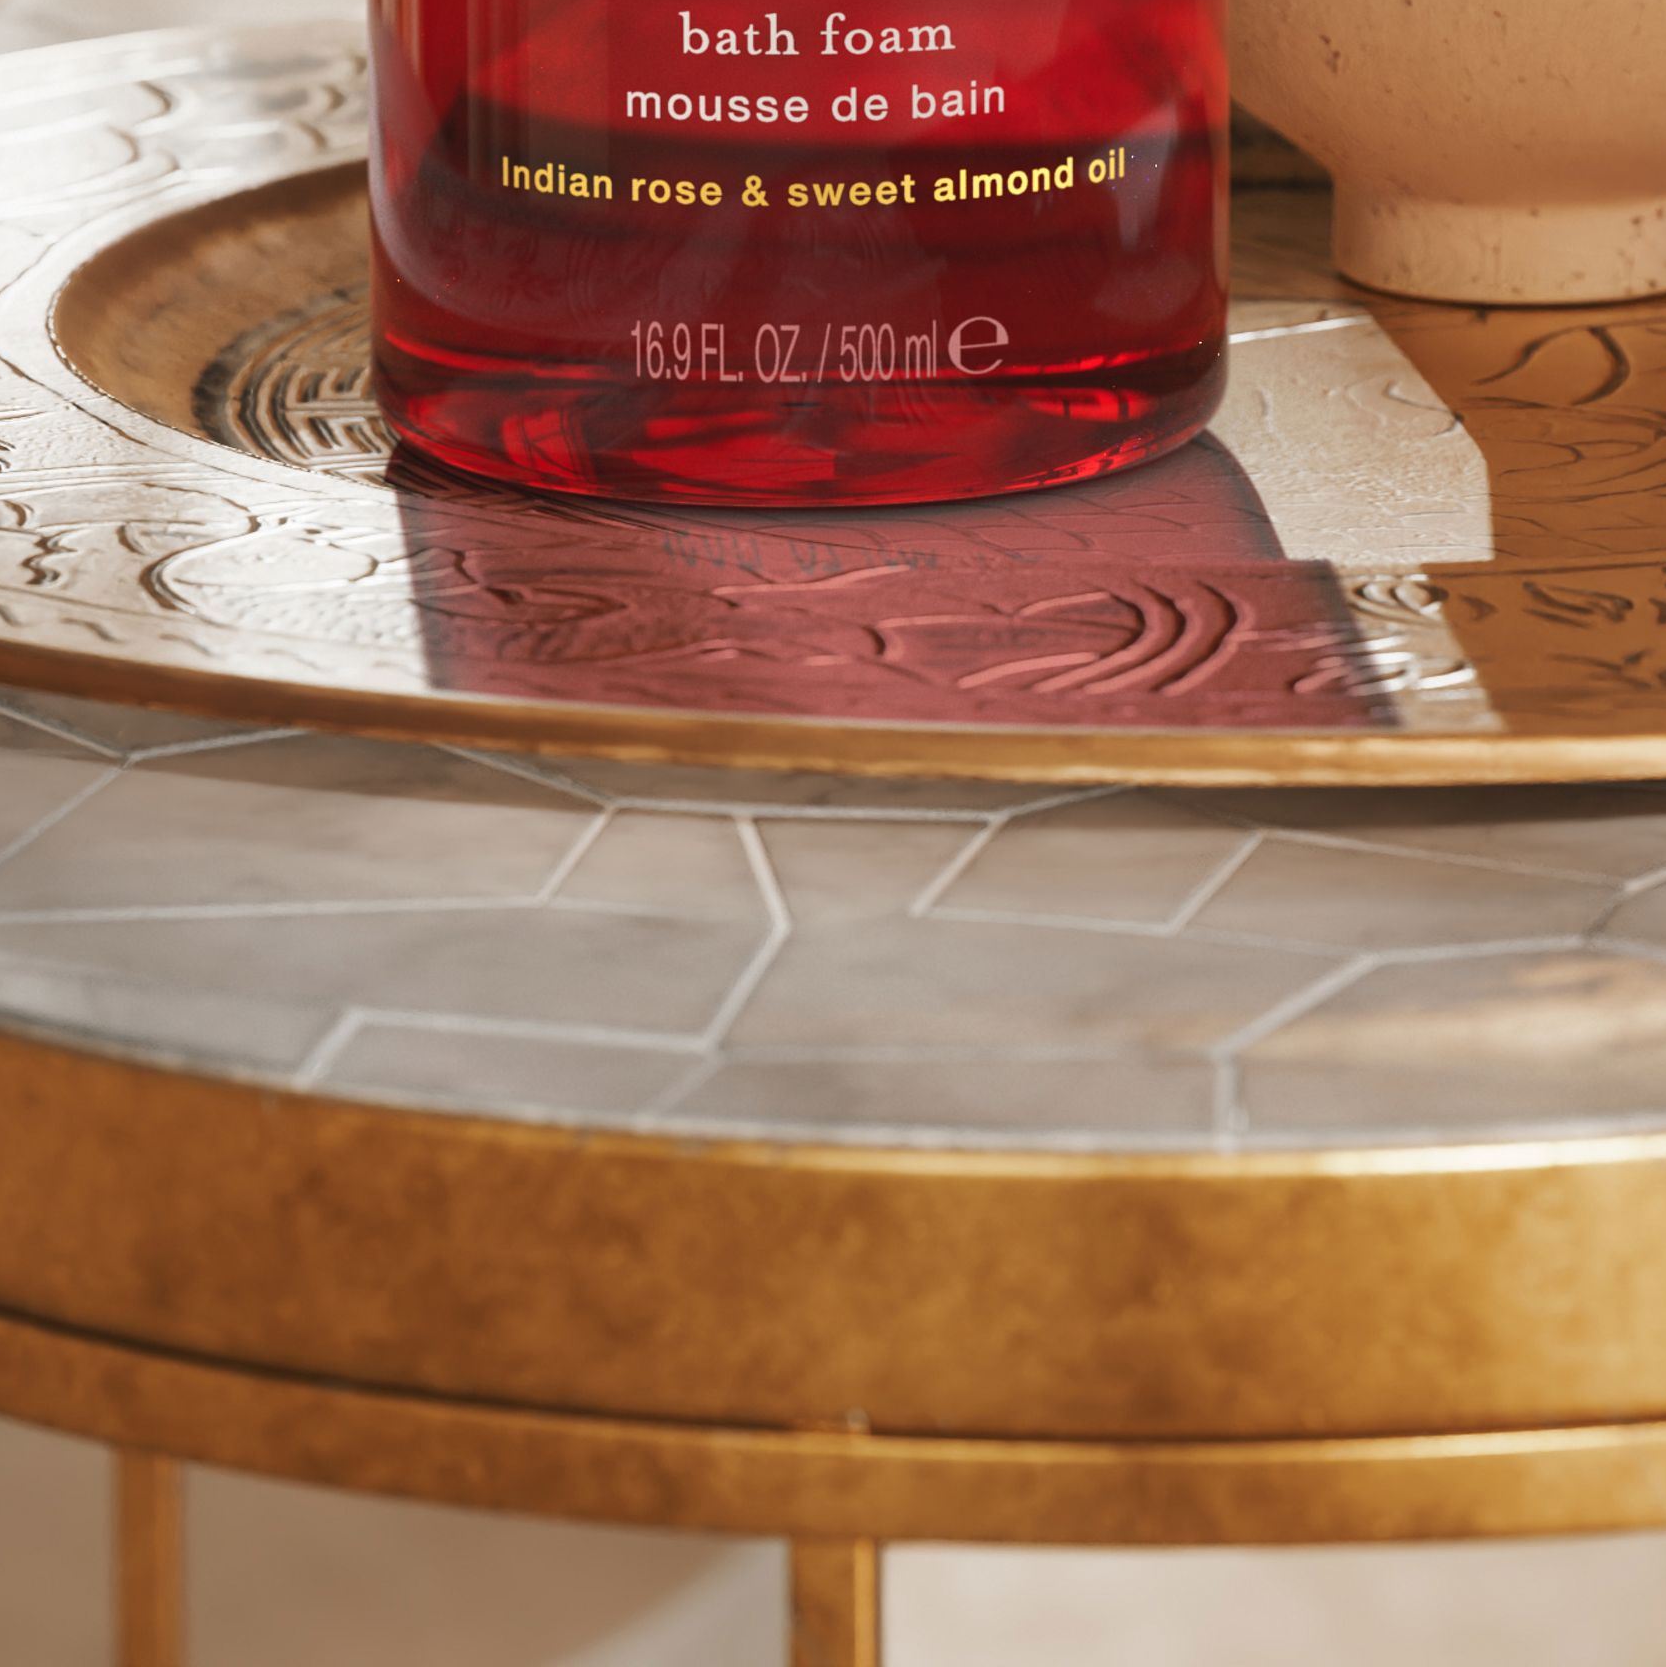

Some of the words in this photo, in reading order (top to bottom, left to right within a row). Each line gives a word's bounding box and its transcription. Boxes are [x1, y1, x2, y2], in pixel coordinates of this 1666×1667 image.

[678, 11, 799, 56] bath
[820, 13, 956, 55] foam
[626, 89, 809, 123] mousse
[832, 87, 889, 122] de
[911, 81, 1006, 120] bain
[502, 156, 613, 199] Indian
[631, 176, 722, 205] rose
[741, 175, 769, 207] &
[787, 173, 916, 207] sweet
[933, 156, 1075, 202] almond
[1088, 147, 1126, 184] oil
[630, 320, 692, 380] 16.9
[701, 323, 744, 383] FL.
[754, 324, 807, 384] OZ.
[817, 322, 832, 384] /
[839, 323, 896, 381] 500
[905, 319, 938, 378] ml
